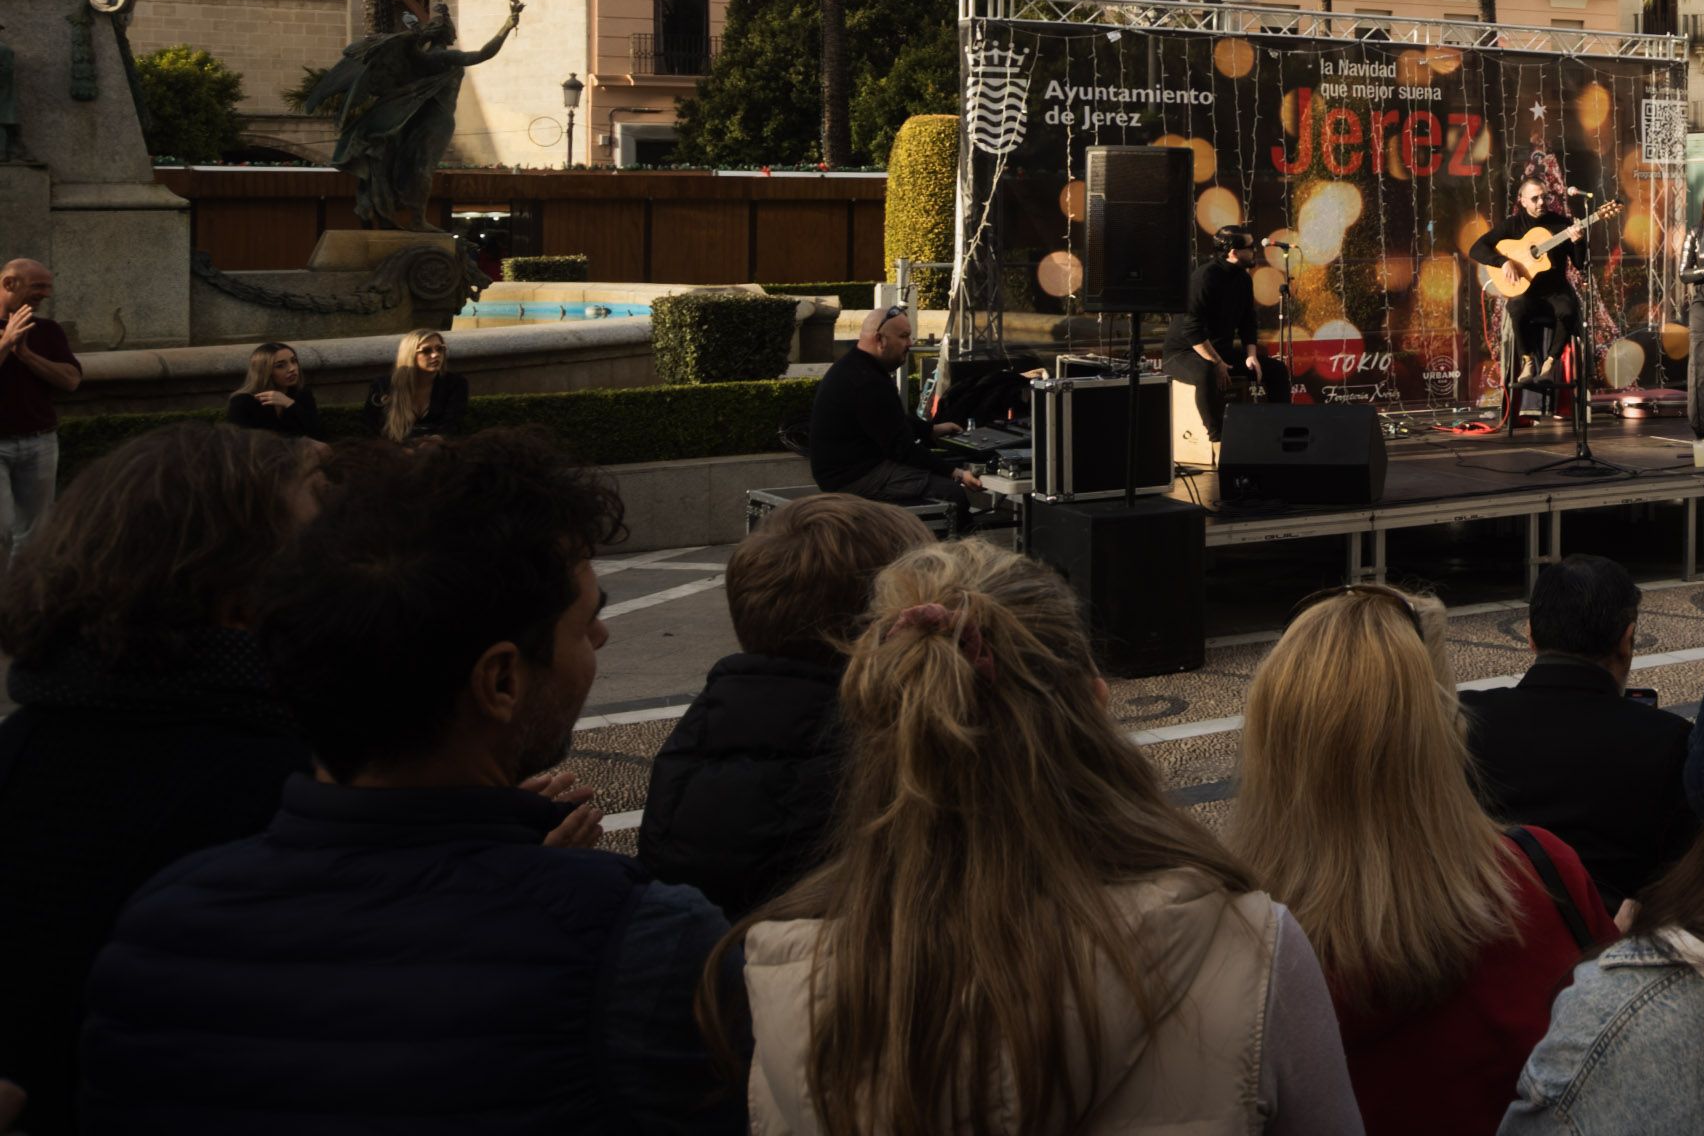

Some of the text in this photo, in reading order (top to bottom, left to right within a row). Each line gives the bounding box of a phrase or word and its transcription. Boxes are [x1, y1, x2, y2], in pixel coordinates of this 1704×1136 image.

[1320, 58, 1397, 79] la Navidad
[1044, 79, 1214, 105] Ayuntamiento
[1320, 82, 1442, 103] que mejor suena
[1044, 105, 1142, 131] de Jerez
[1270, 87, 1483, 177] Jerez
[1330, 352, 1392, 373] TOKIO
[1422, 371, 1461, 380] URBANO
